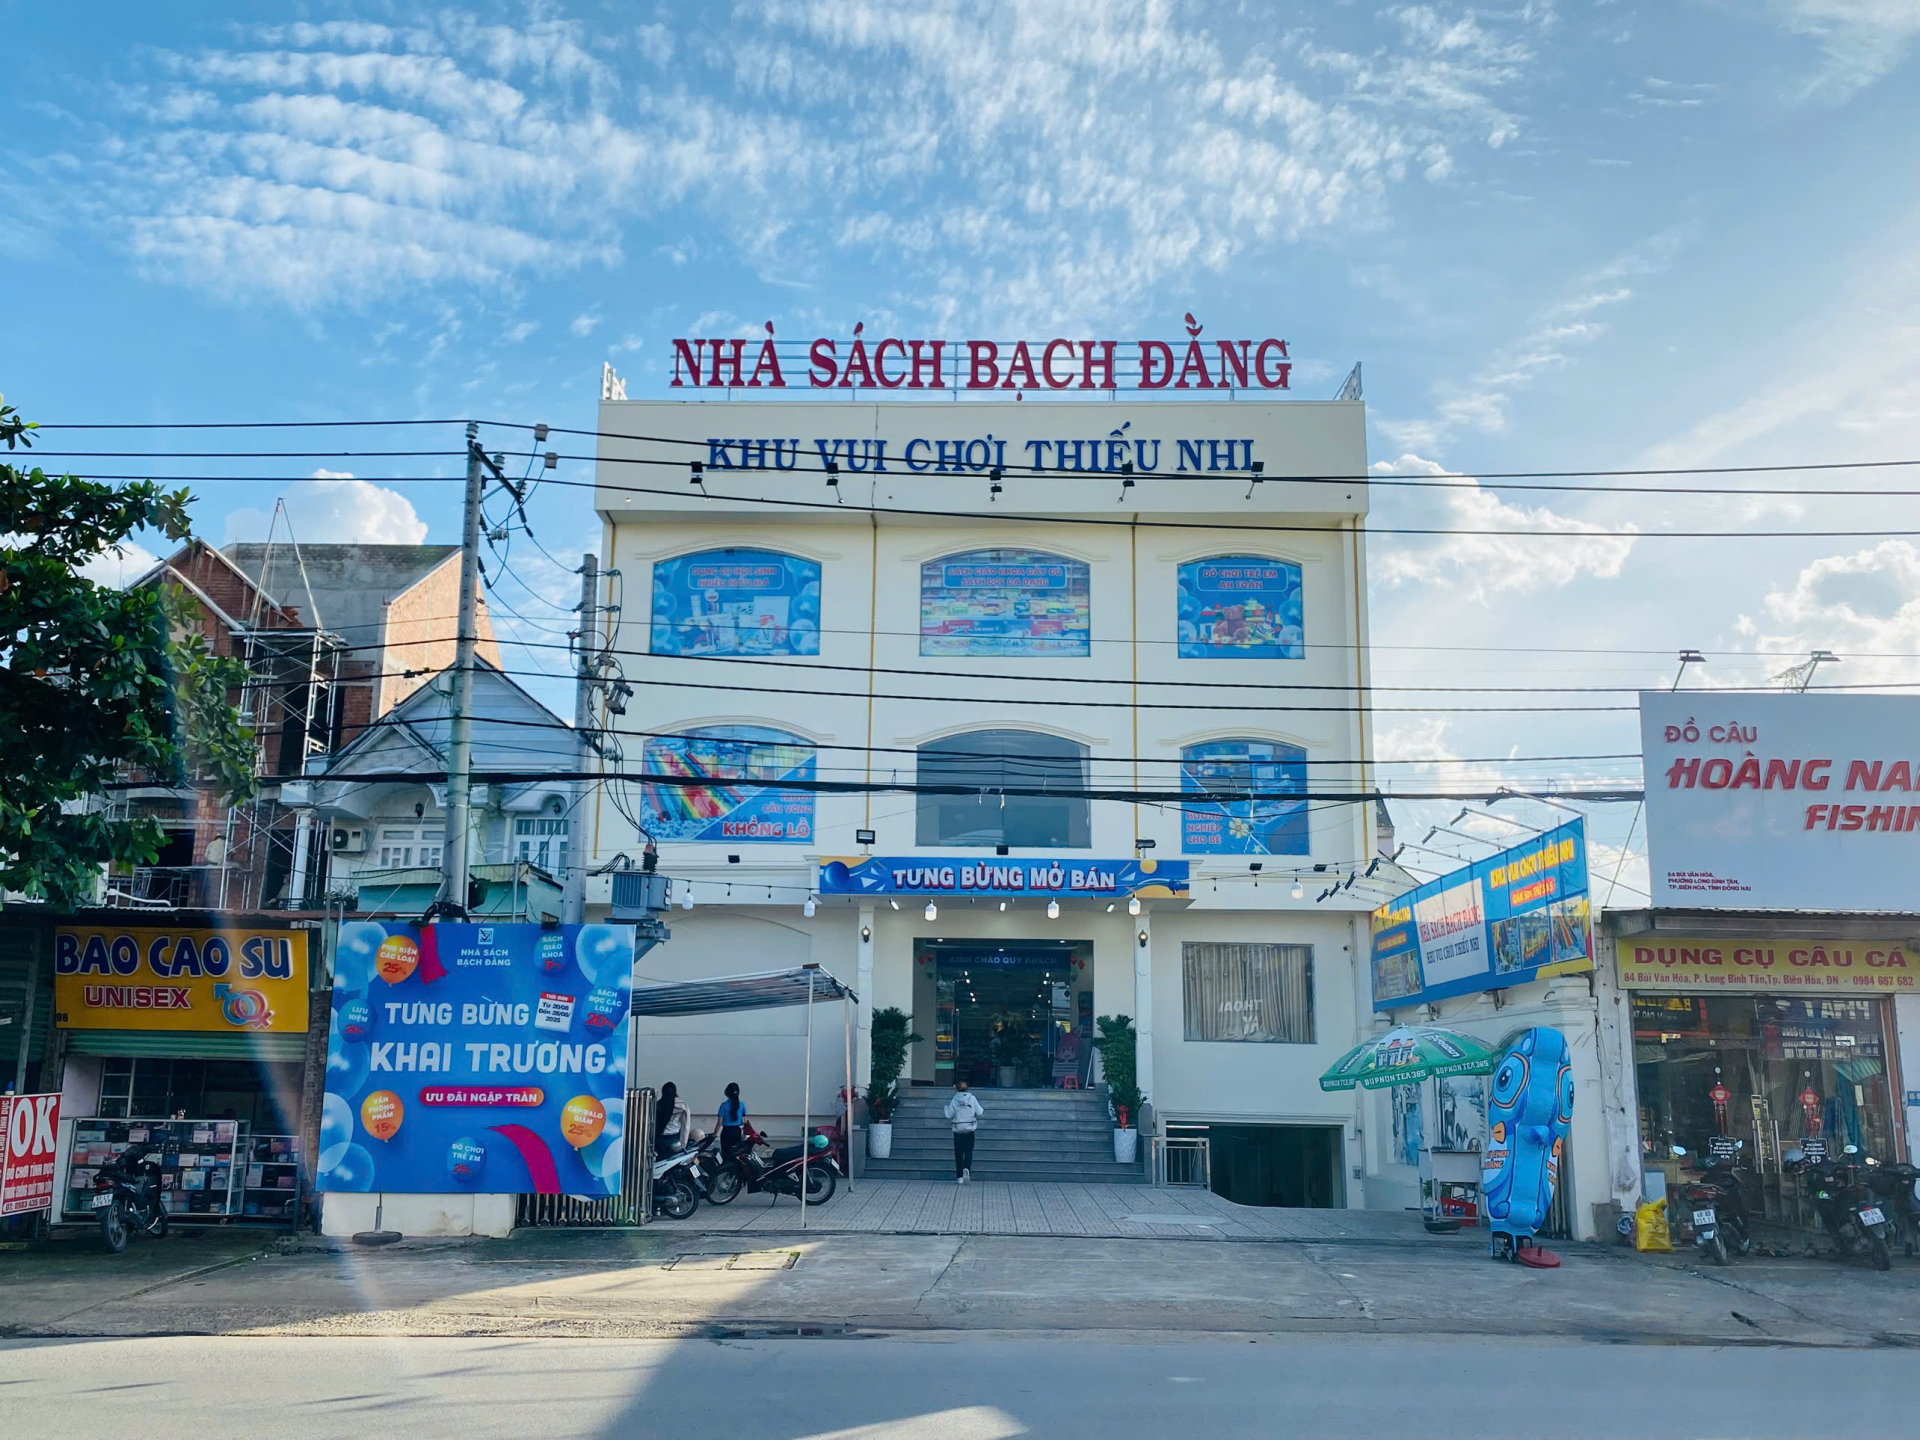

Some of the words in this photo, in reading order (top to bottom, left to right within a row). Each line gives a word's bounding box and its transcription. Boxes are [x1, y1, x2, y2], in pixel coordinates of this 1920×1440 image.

[672, 320, 786, 387] NHÀ
[808, 321, 945, 389] SÁCH
[965, 338, 1117, 401] BẠCH
[1138, 312, 1292, 390] ĐẰNG
[706, 438, 800, 471] KHU
[814, 439, 888, 472] VUI
[905, 433, 1007, 473] CHƠI
[1025, 421, 1161, 473] THIẾU
[1176, 439, 1255, 472] NHI
[754, 567, 776, 576] SINH
[998, 567, 1025, 576] KHOA
[1203, 567, 1217, 578] ĐỒ
[1219, 568, 1241, 578] CHƠI
[1263, 569, 1278, 579] EM
[1218, 581, 1234, 590] AN
[1236, 579, 1263, 590] TOÀN
[1664, 716, 1700, 743] ĐỒ
[1709, 721, 1758, 743] CÂU
[1665, 750, 1833, 791] HOÀNG
[1844, 760, 1920, 791] NA
[722, 815, 784, 837] KHỔNG
[786, 816, 811, 838] LỒ
[1186, 822, 1221, 834] NGHIỆP
[1187, 835, 1207, 844] CHO
[1208, 834, 1221, 844] BÉ
[892, 866, 954, 889] TƯNG
[1030, 860, 1065, 890] MỞ
[1074, 866, 1116, 891] BÁN
[56, 934, 139, 976] BAO
[148, 936, 230, 978] CAO
[239, 937, 294, 980] SU
[457, 958, 482, 968] BẠCH
[461, 947, 480, 956] NHÀ
[483, 947, 508, 956] SÁCH
[1634, 947, 1723, 968] DỤNG
[1733, 948, 1775, 970] CỤ
[1788, 945, 1852, 967] CÂU
[1865, 946, 1907, 968] CÁ
[1624, 972, 1635, 982] 84
[1637, 972, 1652, 982] Bùi
[1654, 972, 1672, 983] Văn
[1704, 974, 1725, 986] Long
[1727, 973, 1747, 984] Bình
[1783, 973, 1802, 985] Biên
[1826, 975, 1839, 985] ĐN
[1853, 976, 1876, 986] 0984
[1878, 976, 1894, 986] 687
[1896, 976, 1914, 986] 682
[84, 985, 192, 1009] UNISEX
[385, 1000, 451, 1025] TƯNG
[461, 995, 530, 1026] BỪNG
[370, 1042, 451, 1072] KHAI
[465, 1040, 606, 1073] TRƯƠNG
[425, 1091, 445, 1102] ƯU
[447, 1091, 467, 1102] ĐÃI
[470, 1091, 502, 1105] NGẬP
[506, 1091, 537, 1103] TRÀN
[11, 1096, 57, 1158] OK
[469, 1154, 481, 1162] EM
